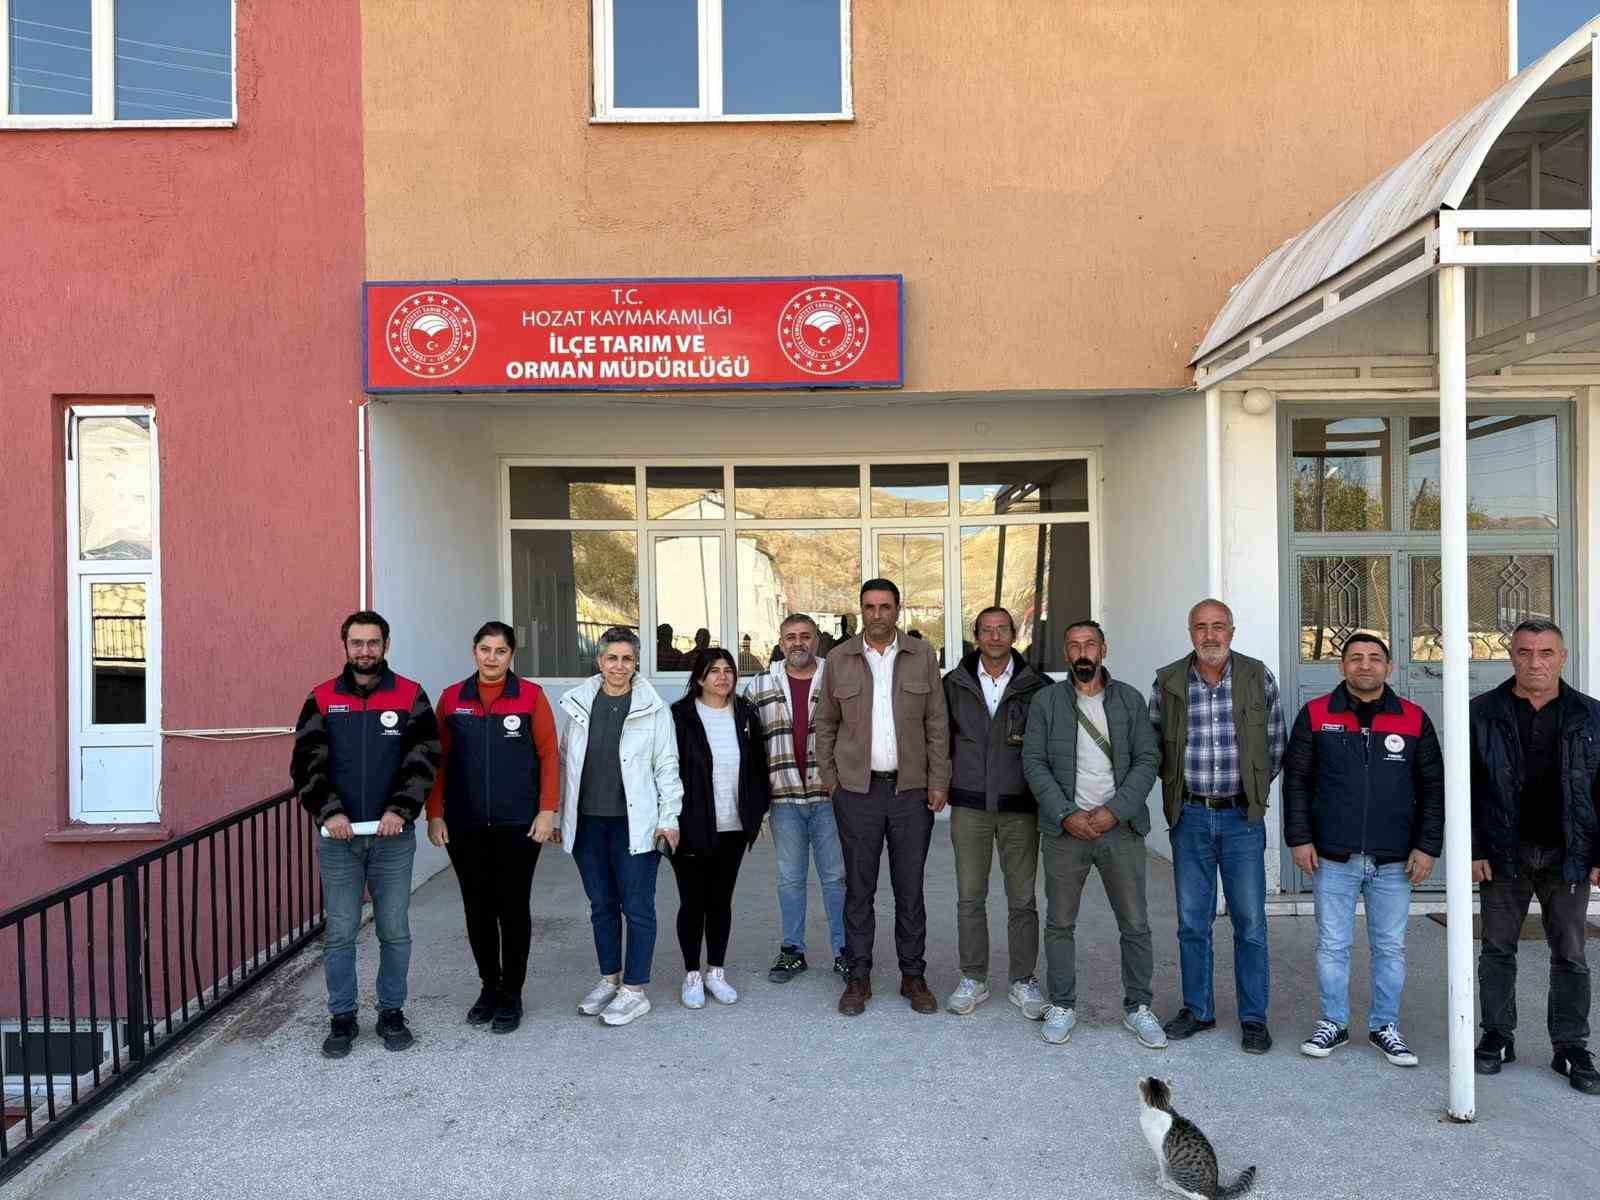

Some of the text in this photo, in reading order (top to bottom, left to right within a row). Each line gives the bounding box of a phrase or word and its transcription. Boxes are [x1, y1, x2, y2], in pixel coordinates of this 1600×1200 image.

[611, 288, 643, 305] T.C.
[522, 306, 732, 327] HOZAT KAYMAKAMLIĞI
[549, 332, 705, 358] İLÇE TARIM VE
[506, 355, 750, 379] ORMAN MÜDÜRLÜĞÜ
